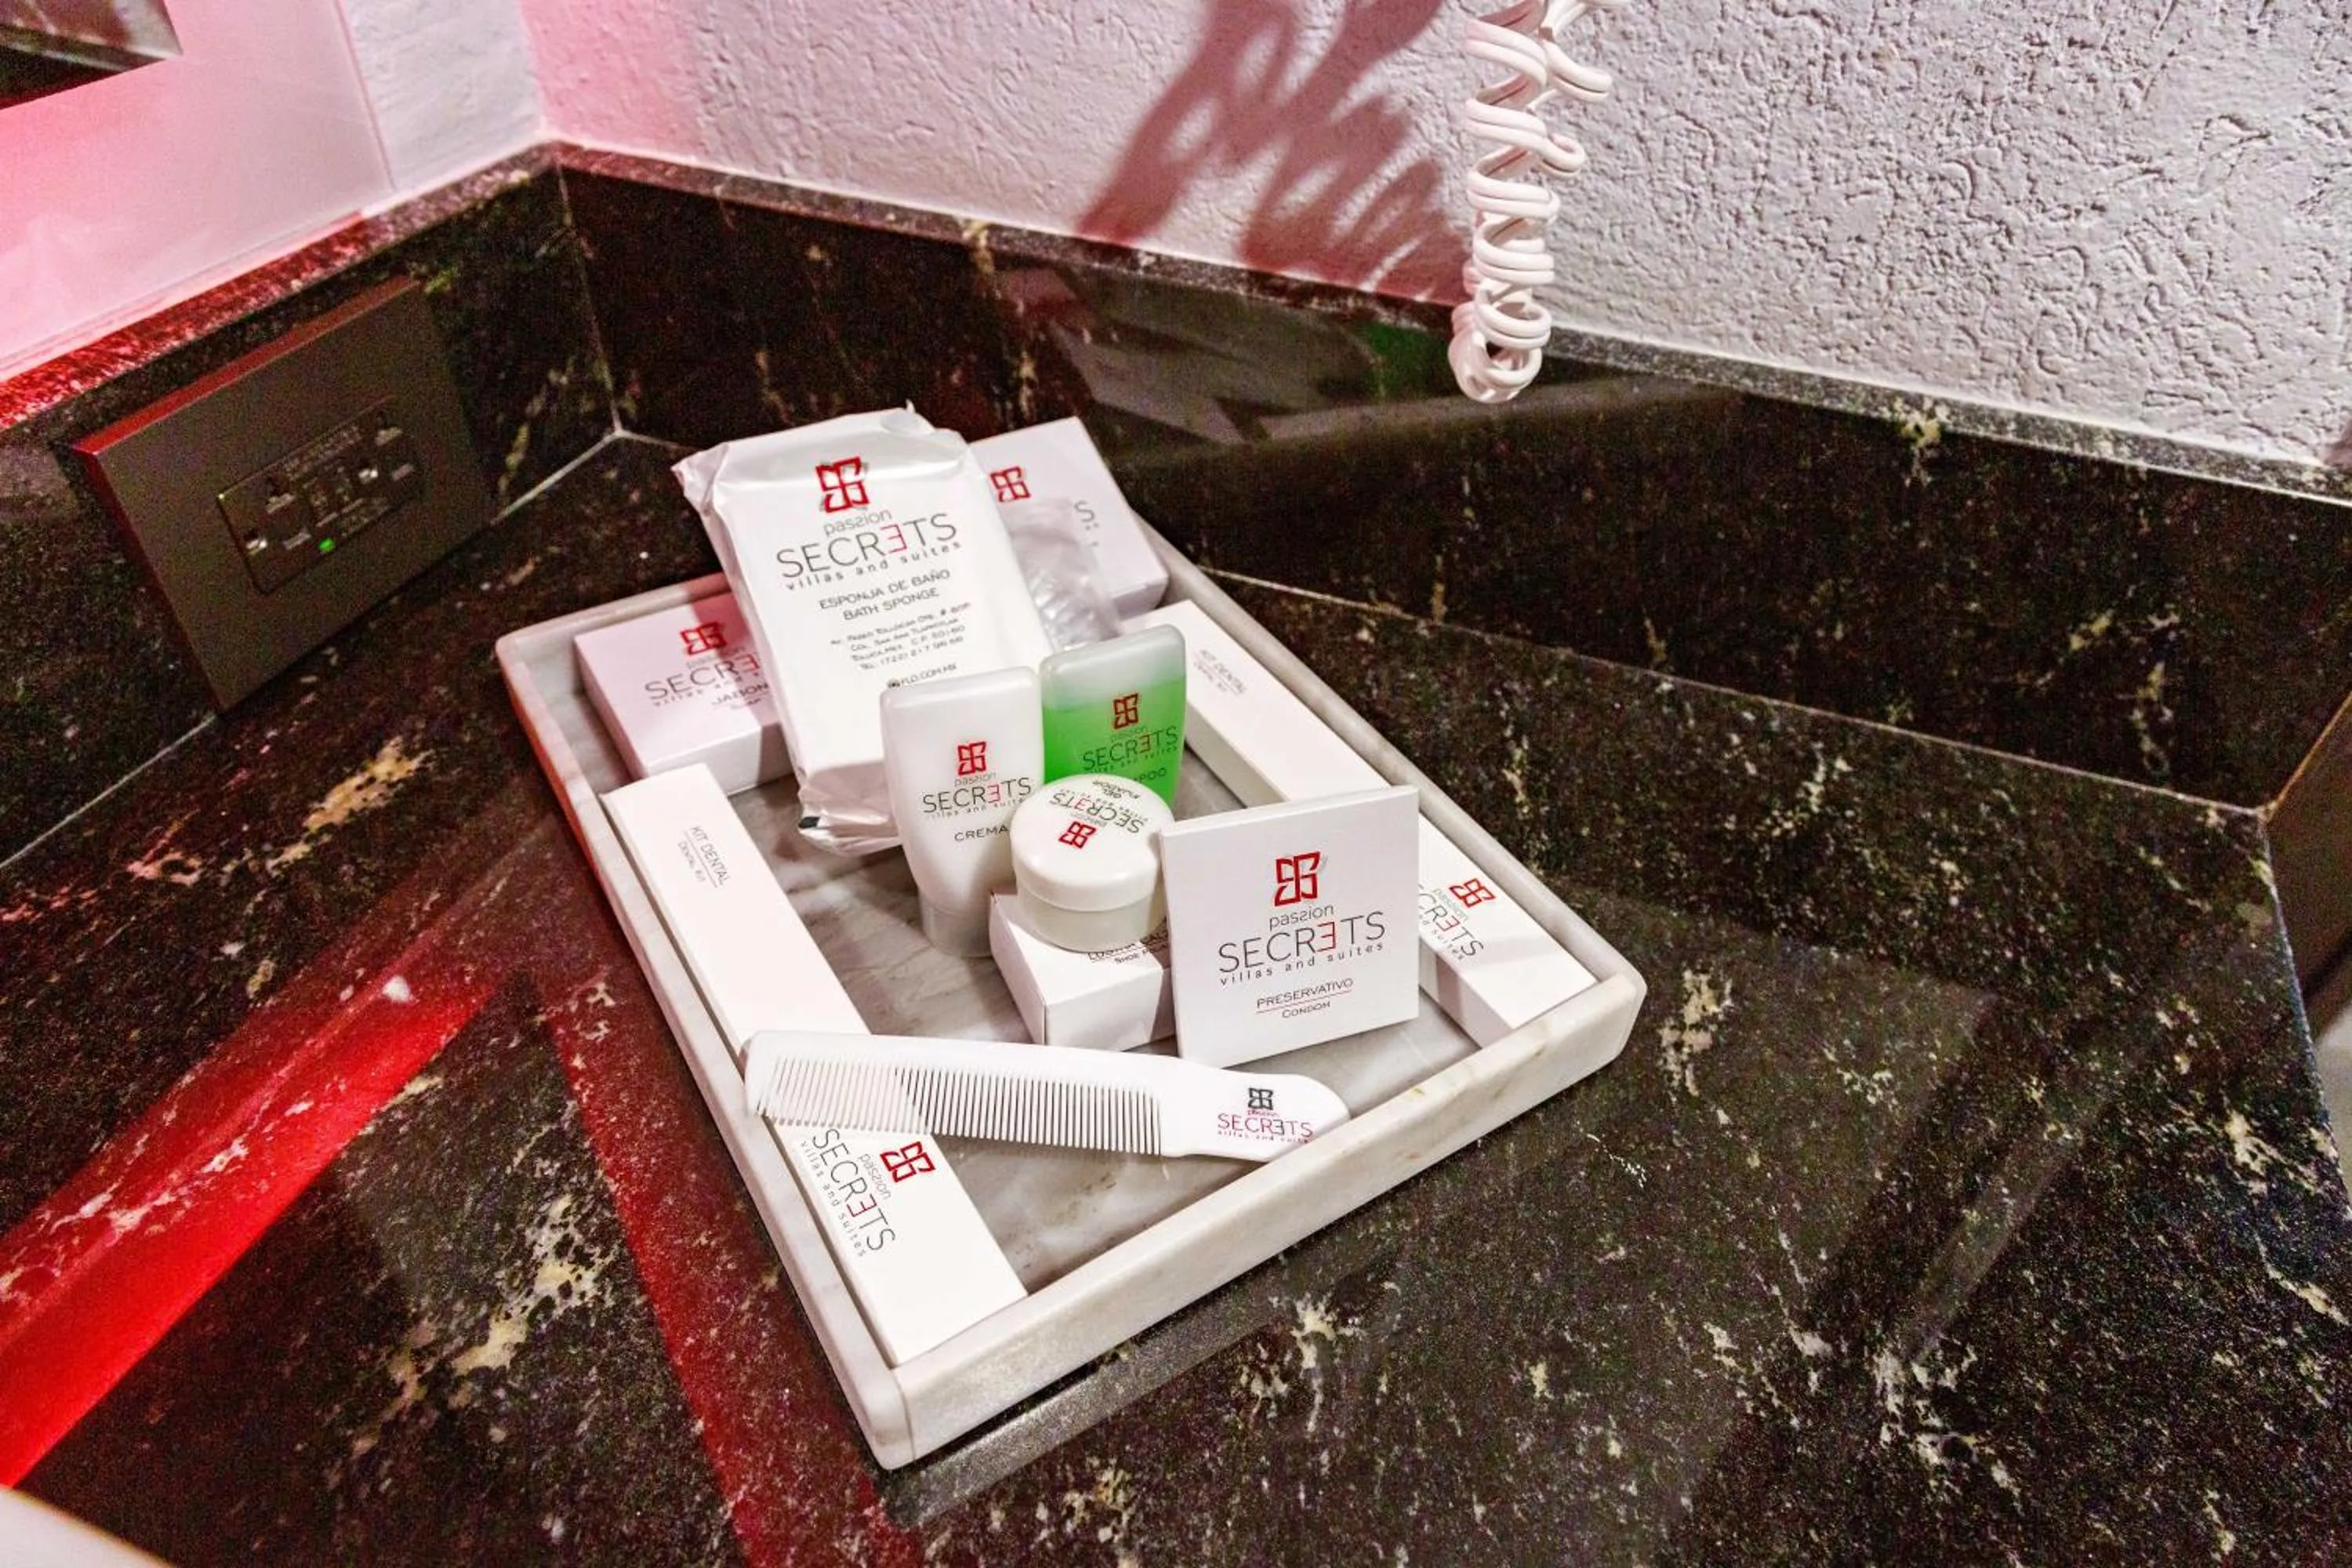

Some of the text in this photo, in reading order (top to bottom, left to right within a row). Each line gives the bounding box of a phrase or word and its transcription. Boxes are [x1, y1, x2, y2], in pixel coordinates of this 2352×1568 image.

[786, 541, 962, 590] villas and suites
[818, 568, 951, 609] ESPONJA DE BAÑO
[842, 587, 941, 621] BATH SPONGE
[644, 653, 760, 700] SECRE
[954, 824, 1010, 842] CREMA
[1221, 942, 1384, 986] villas and suites
[1257, 978, 1354, 1009] PRESERVATIVO
[1281, 1000, 1331, 1018] CONDOM
[800, 1140, 867, 1258] villas and suites
